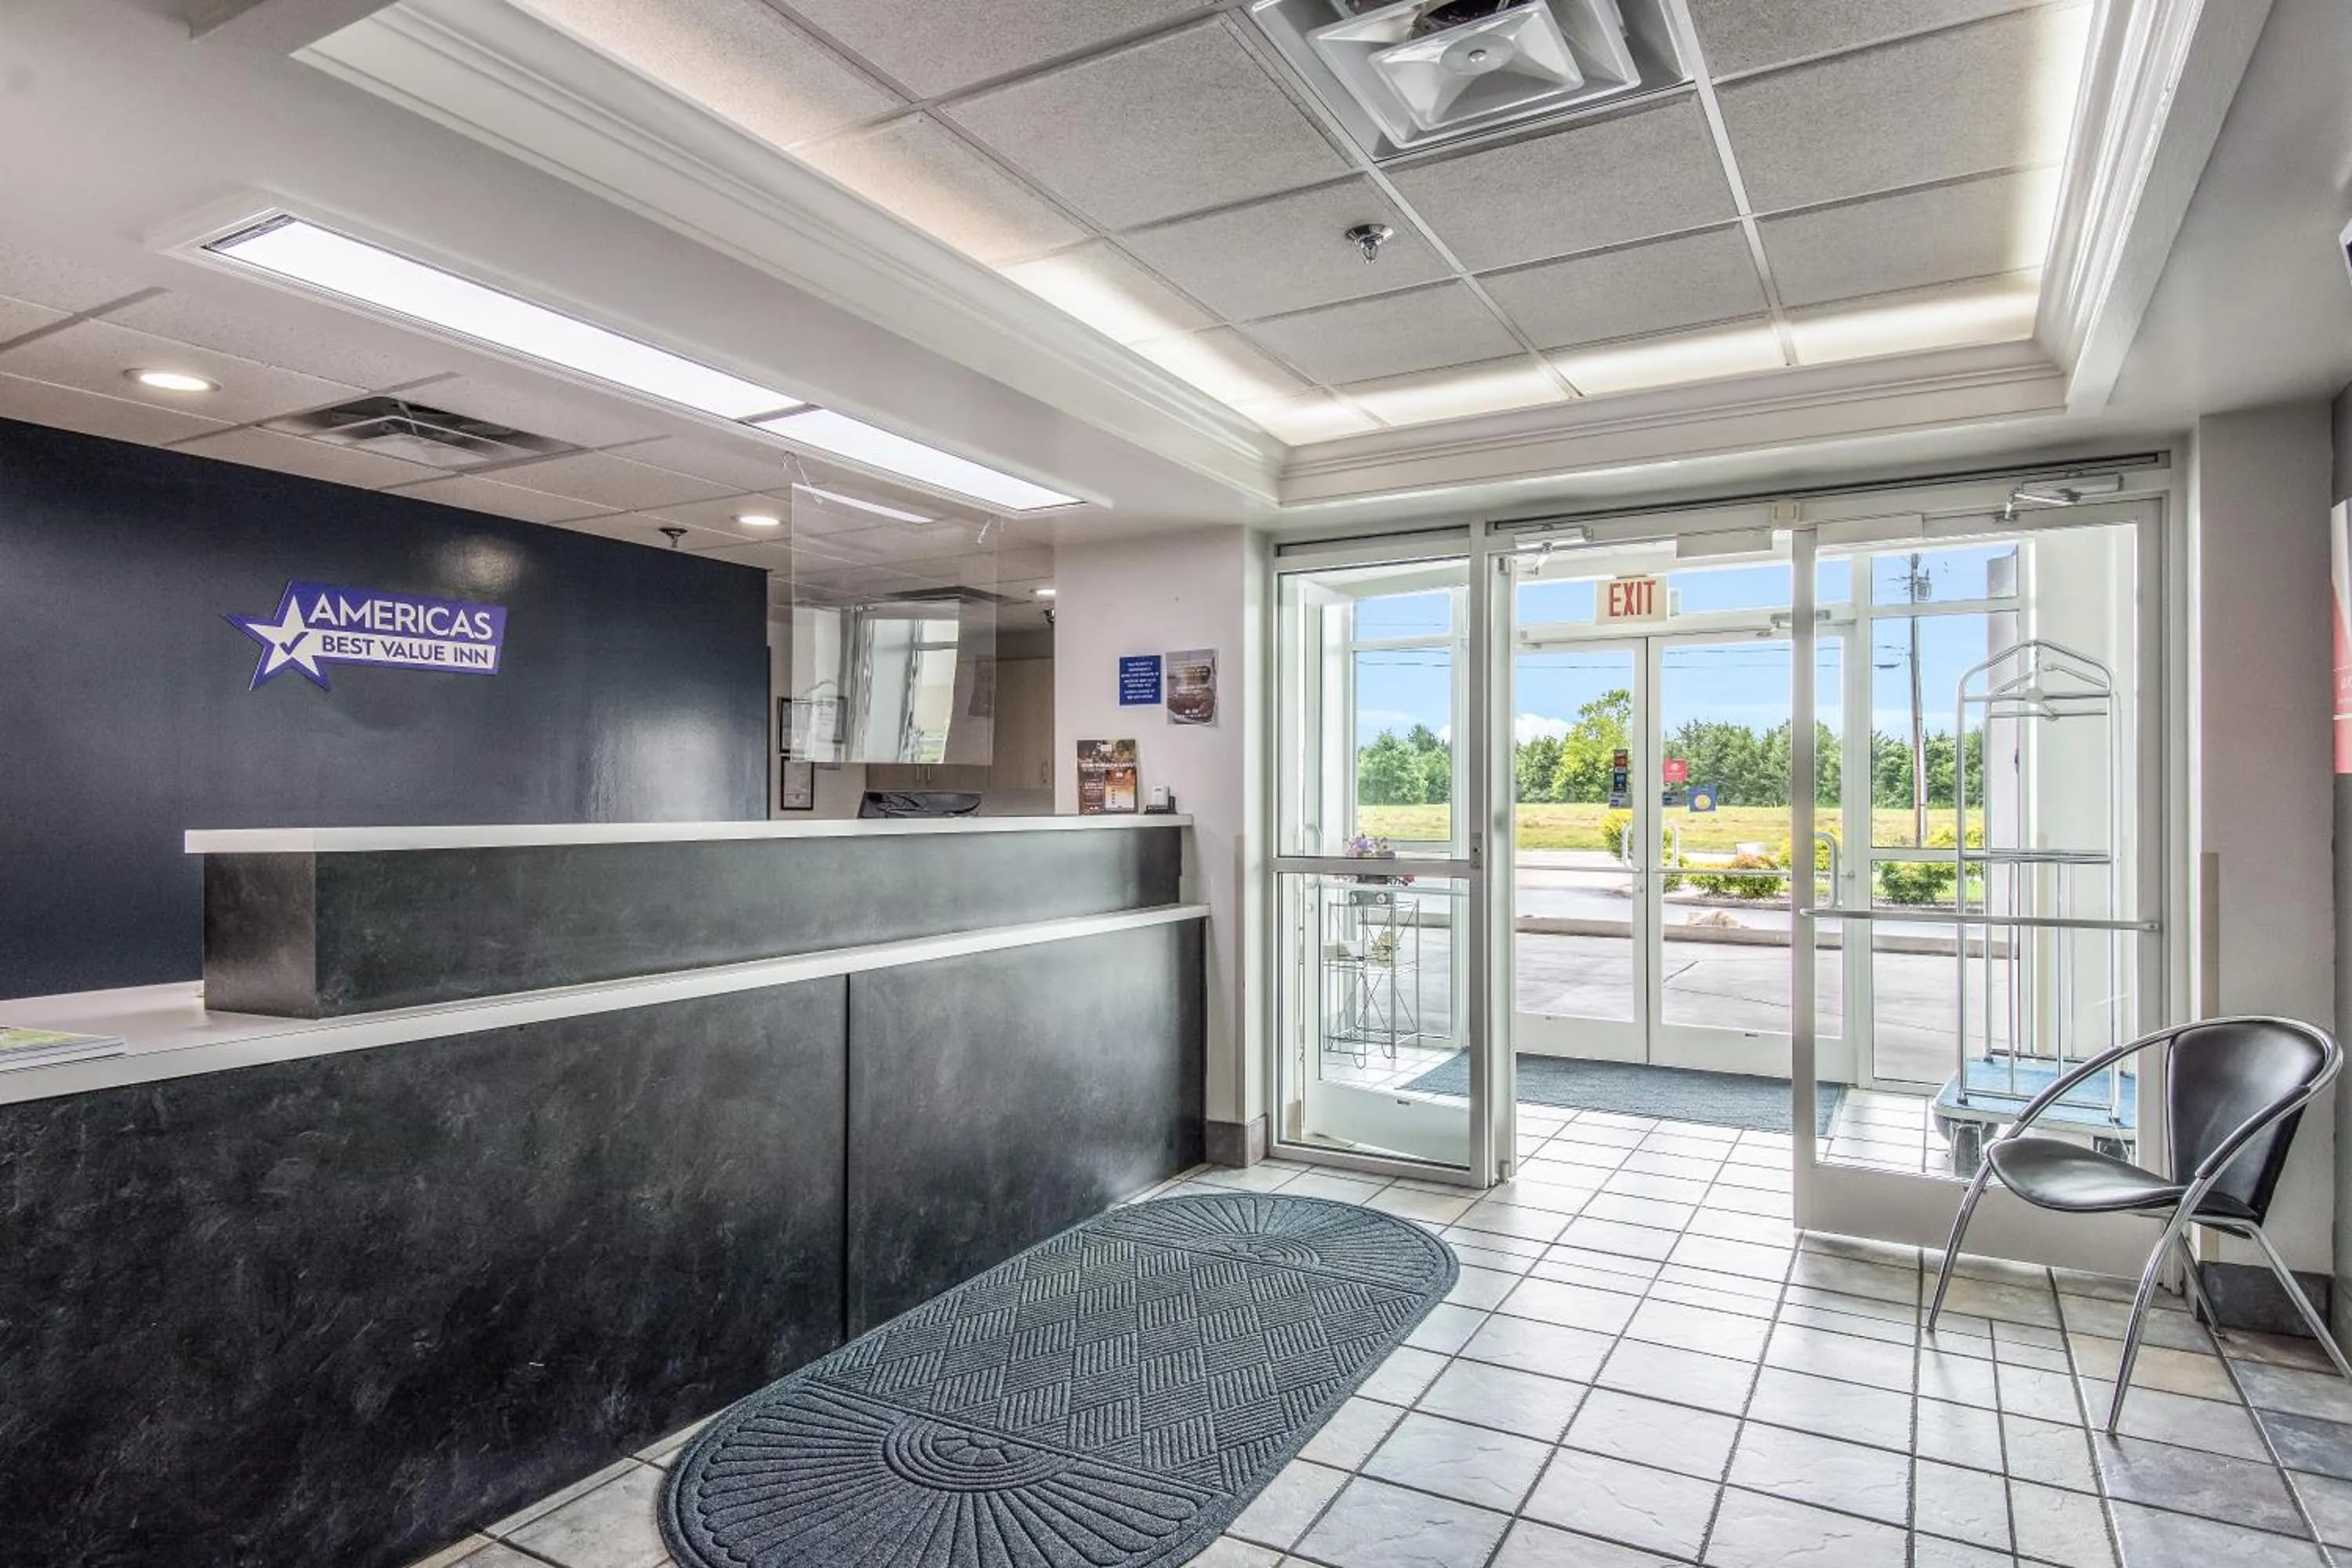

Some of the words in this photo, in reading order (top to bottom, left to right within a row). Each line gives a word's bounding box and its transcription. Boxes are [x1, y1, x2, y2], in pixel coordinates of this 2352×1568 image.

[1609, 580, 1656, 616] EXIT
[309, 593, 492, 640] AMERICAS
[322, 635, 374, 655] BEST
[380, 641, 445, 660] VALUE
[454, 647, 488, 665] INN
